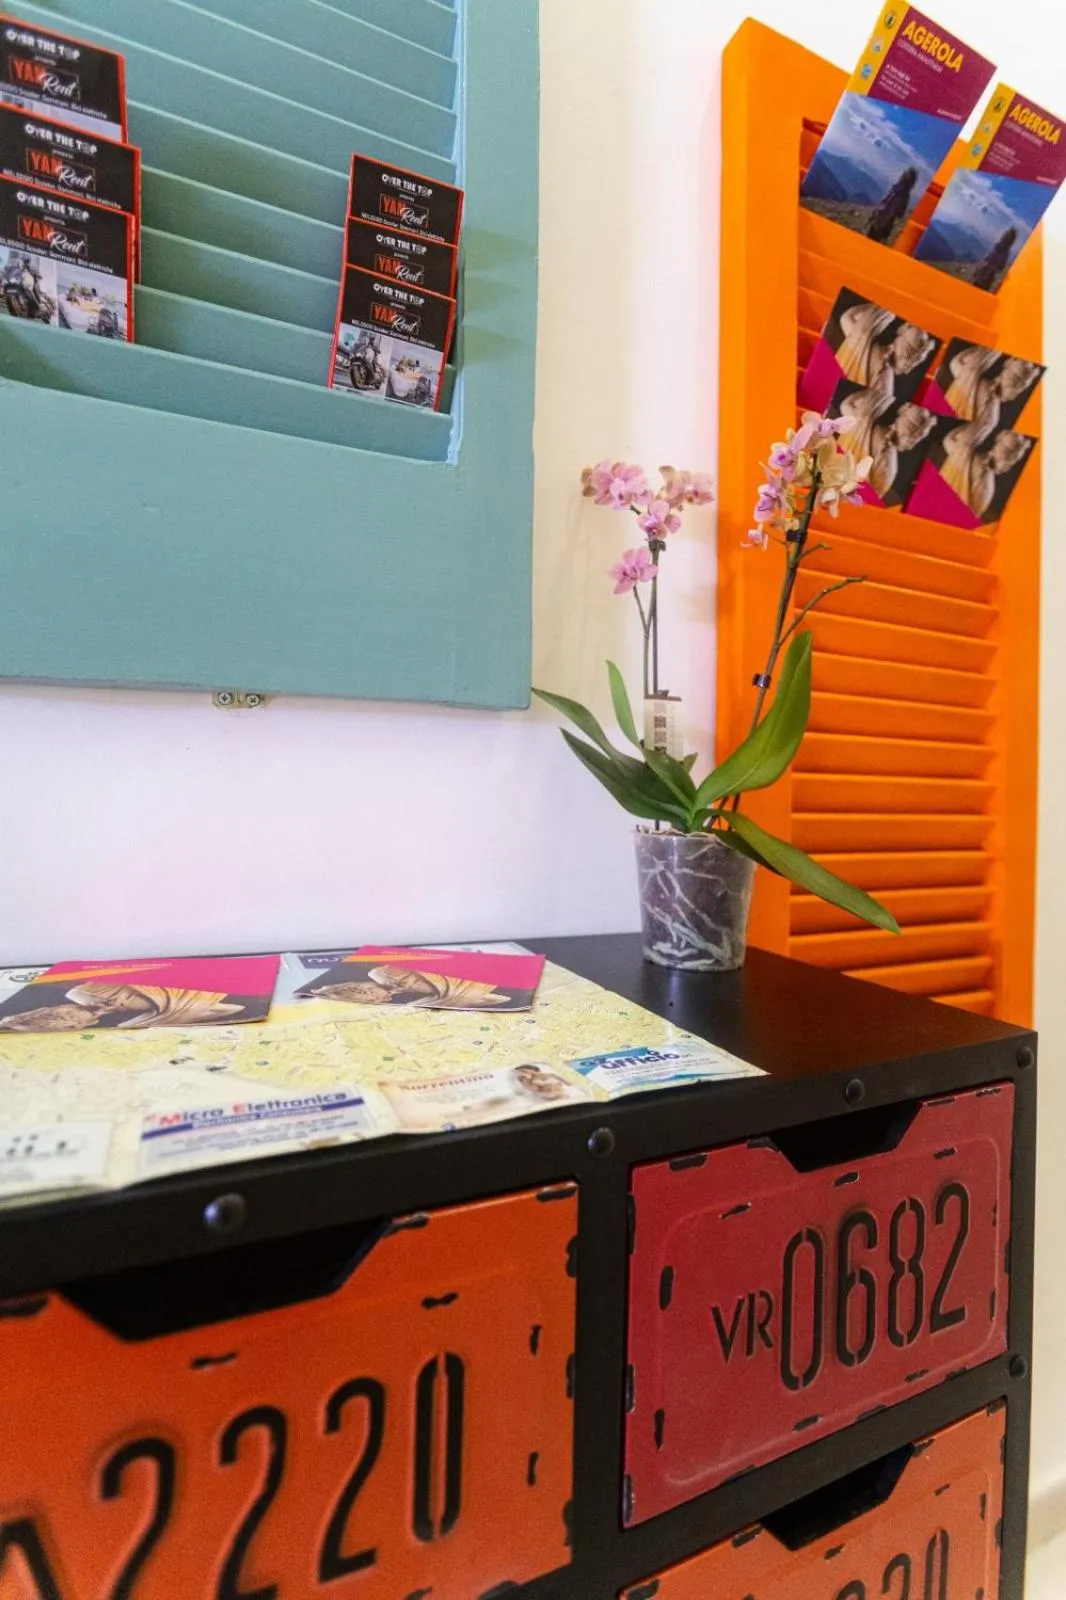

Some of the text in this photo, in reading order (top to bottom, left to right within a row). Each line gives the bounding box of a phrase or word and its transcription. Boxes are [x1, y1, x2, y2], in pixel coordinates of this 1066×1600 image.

[5, 28, 81, 60] OVER THE TOP
[902, 20, 964, 73] AGEROLA
[38, 73, 78, 96] Rent
[1008, 103, 1062, 145] AGEROLA
[25, 123, 53, 141] OVER
[54, 132, 74, 148] THE
[75, 139, 98, 155] TOP
[57, 165, 93, 188] Rent
[381, 174, 401, 187] OVER
[403, 180, 416, 192] THE
[417, 185, 433, 198] TOP
[16, 191, 45, 209] OVER
[46, 199, 66, 215] THE
[67, 206, 90, 222] TOP
[400, 207, 427, 225] Rent
[47, 231, 85, 254] Rent
[376, 233, 427, 255] OVER THE TOP
[395, 265, 424, 283] Rent
[373, 283, 393, 296] OVER
[394, 289, 409, 301] THE
[410, 294, 425, 307] TOP
[391, 315, 417, 332] Rent
[159, 1107, 224, 1126] Micro
[232, 1091, 348, 1115] Elettronica
[711, 1182, 969, 1390] VR 0682
